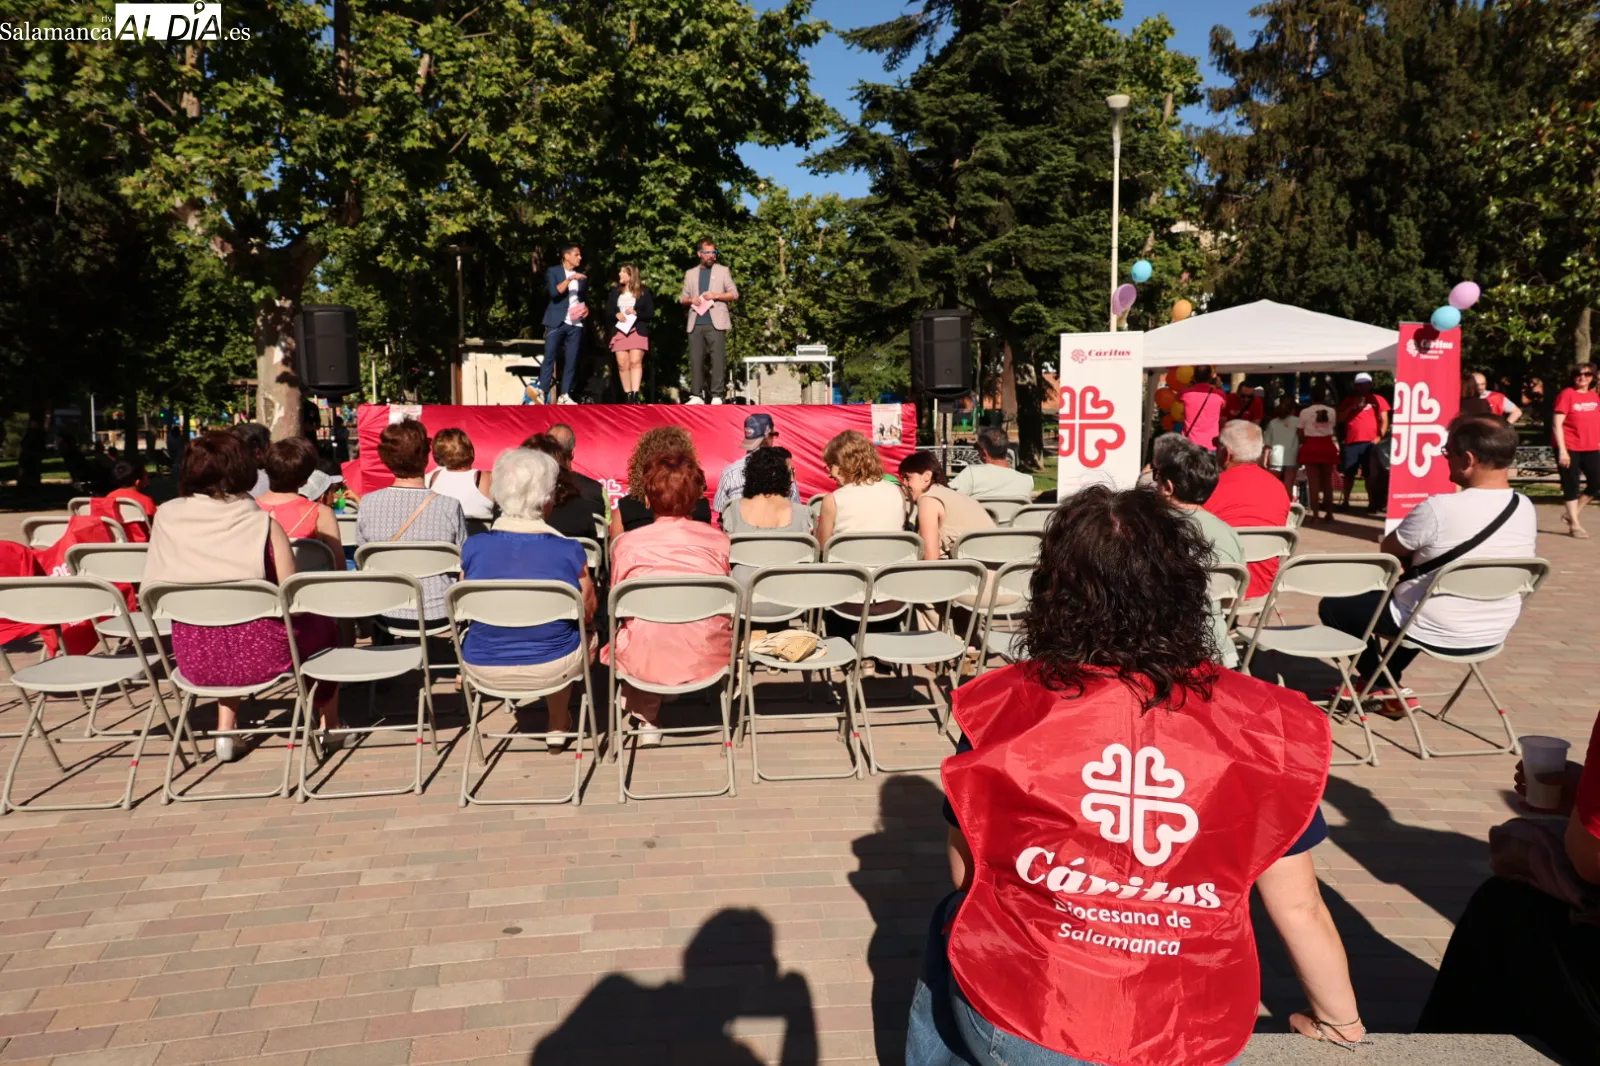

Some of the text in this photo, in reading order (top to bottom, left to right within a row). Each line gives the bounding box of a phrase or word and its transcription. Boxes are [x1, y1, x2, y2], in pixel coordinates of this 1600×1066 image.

[1015, 846, 1221, 909] Cáritas
[1166, 910, 1191, 929] de
[1058, 922, 1181, 956] Salamanca
